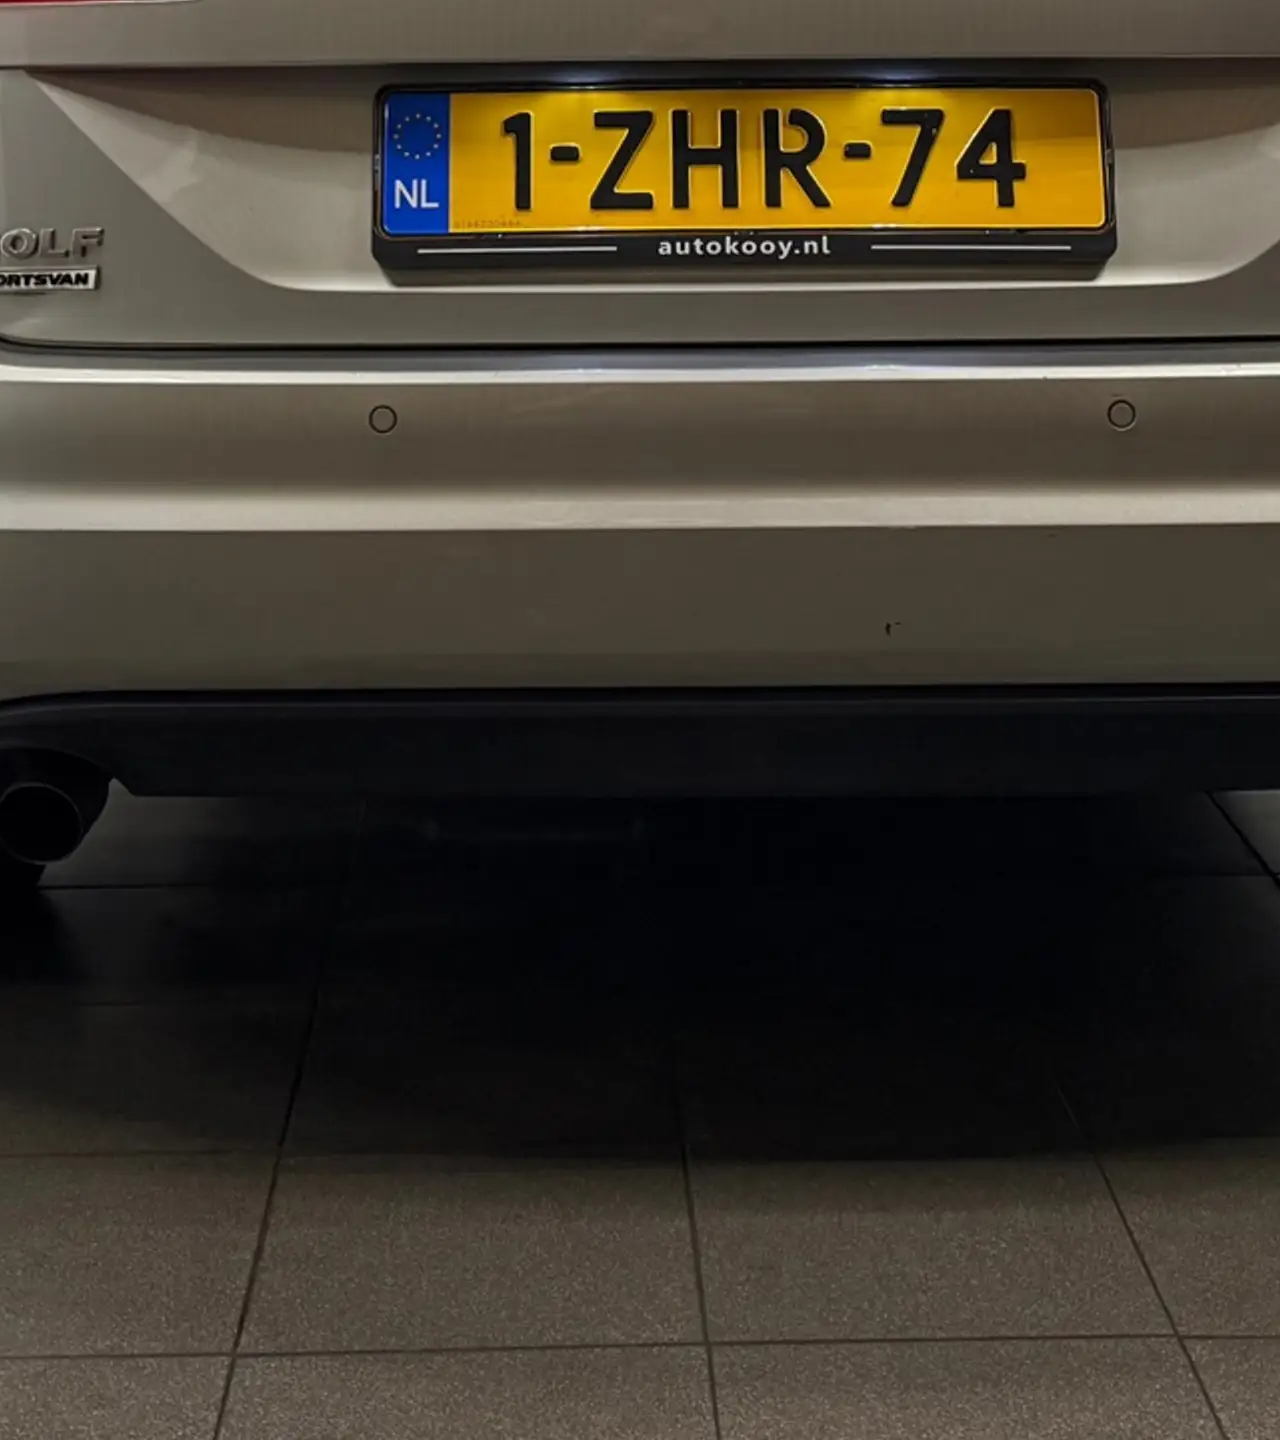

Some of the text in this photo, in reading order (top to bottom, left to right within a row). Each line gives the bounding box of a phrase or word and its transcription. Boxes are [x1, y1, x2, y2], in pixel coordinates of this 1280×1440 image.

[502, 107, 1027, 211] 1-ZHR-74
[394, 178, 440, 209] NL
[658, 235, 831, 260] autokooy.nl
